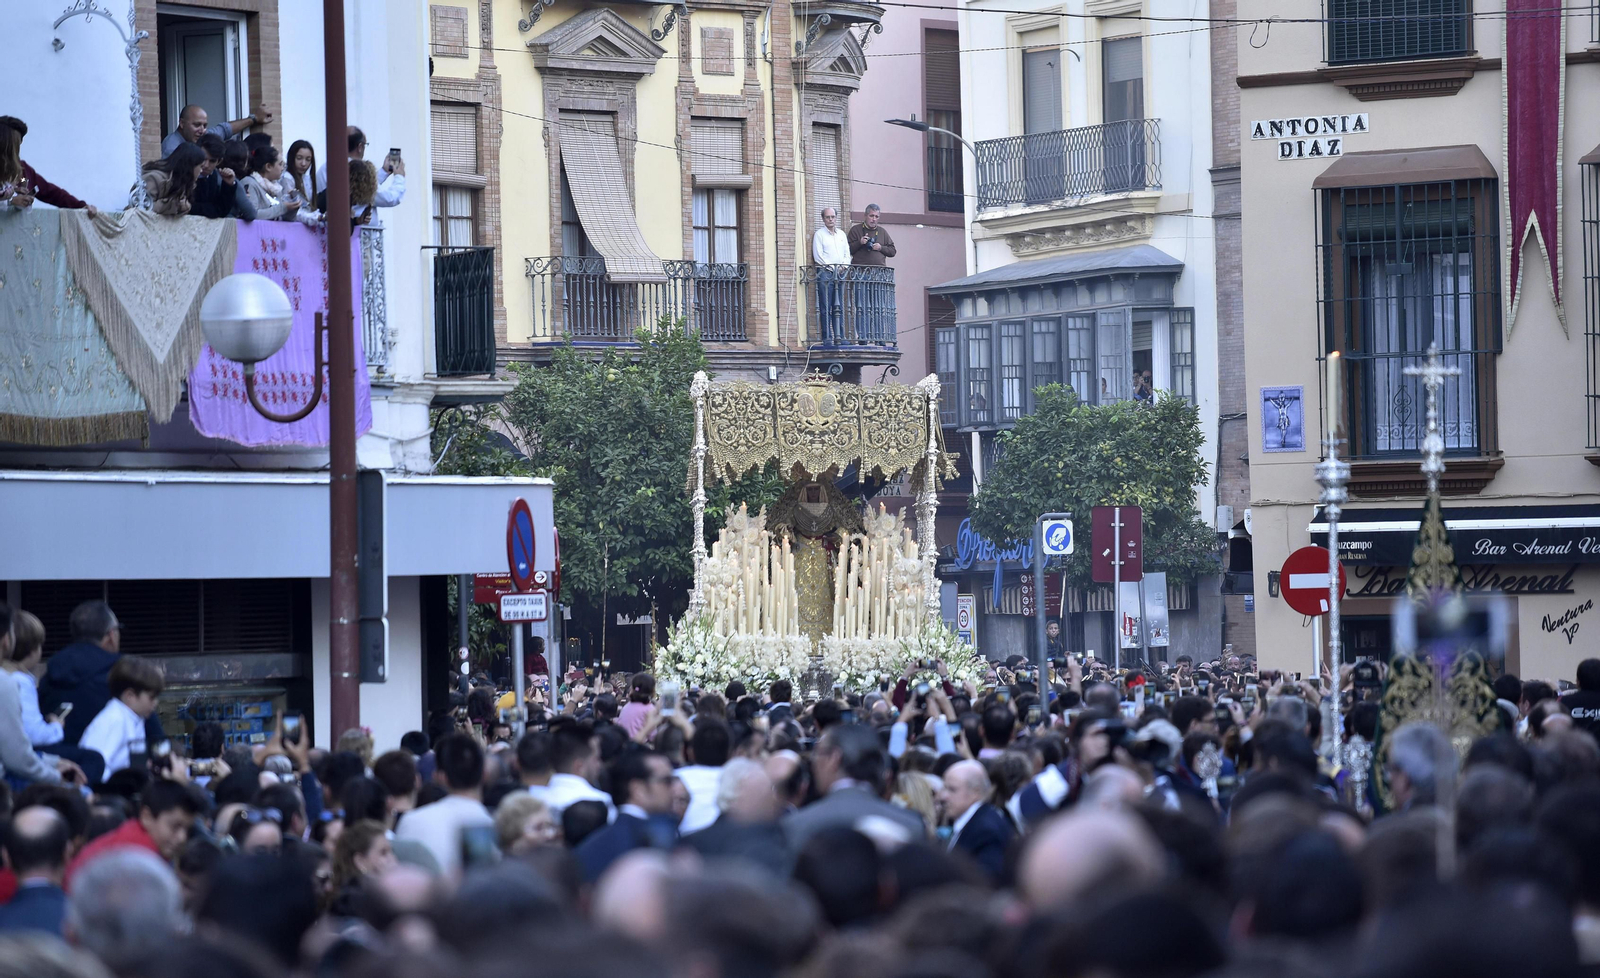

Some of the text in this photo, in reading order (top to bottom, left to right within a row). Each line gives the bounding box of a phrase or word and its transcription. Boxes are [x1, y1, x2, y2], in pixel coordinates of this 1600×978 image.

[1253, 115, 1367, 138] ANTONIA
[1279, 139, 1341, 158] DIAZ
[1338, 541, 1373, 550] uzcampo
[1472, 537, 1600, 556] Bar Arenal Ve
[1346, 565, 1406, 596] Ba
[1542, 599, 1593, 633] Ventura
